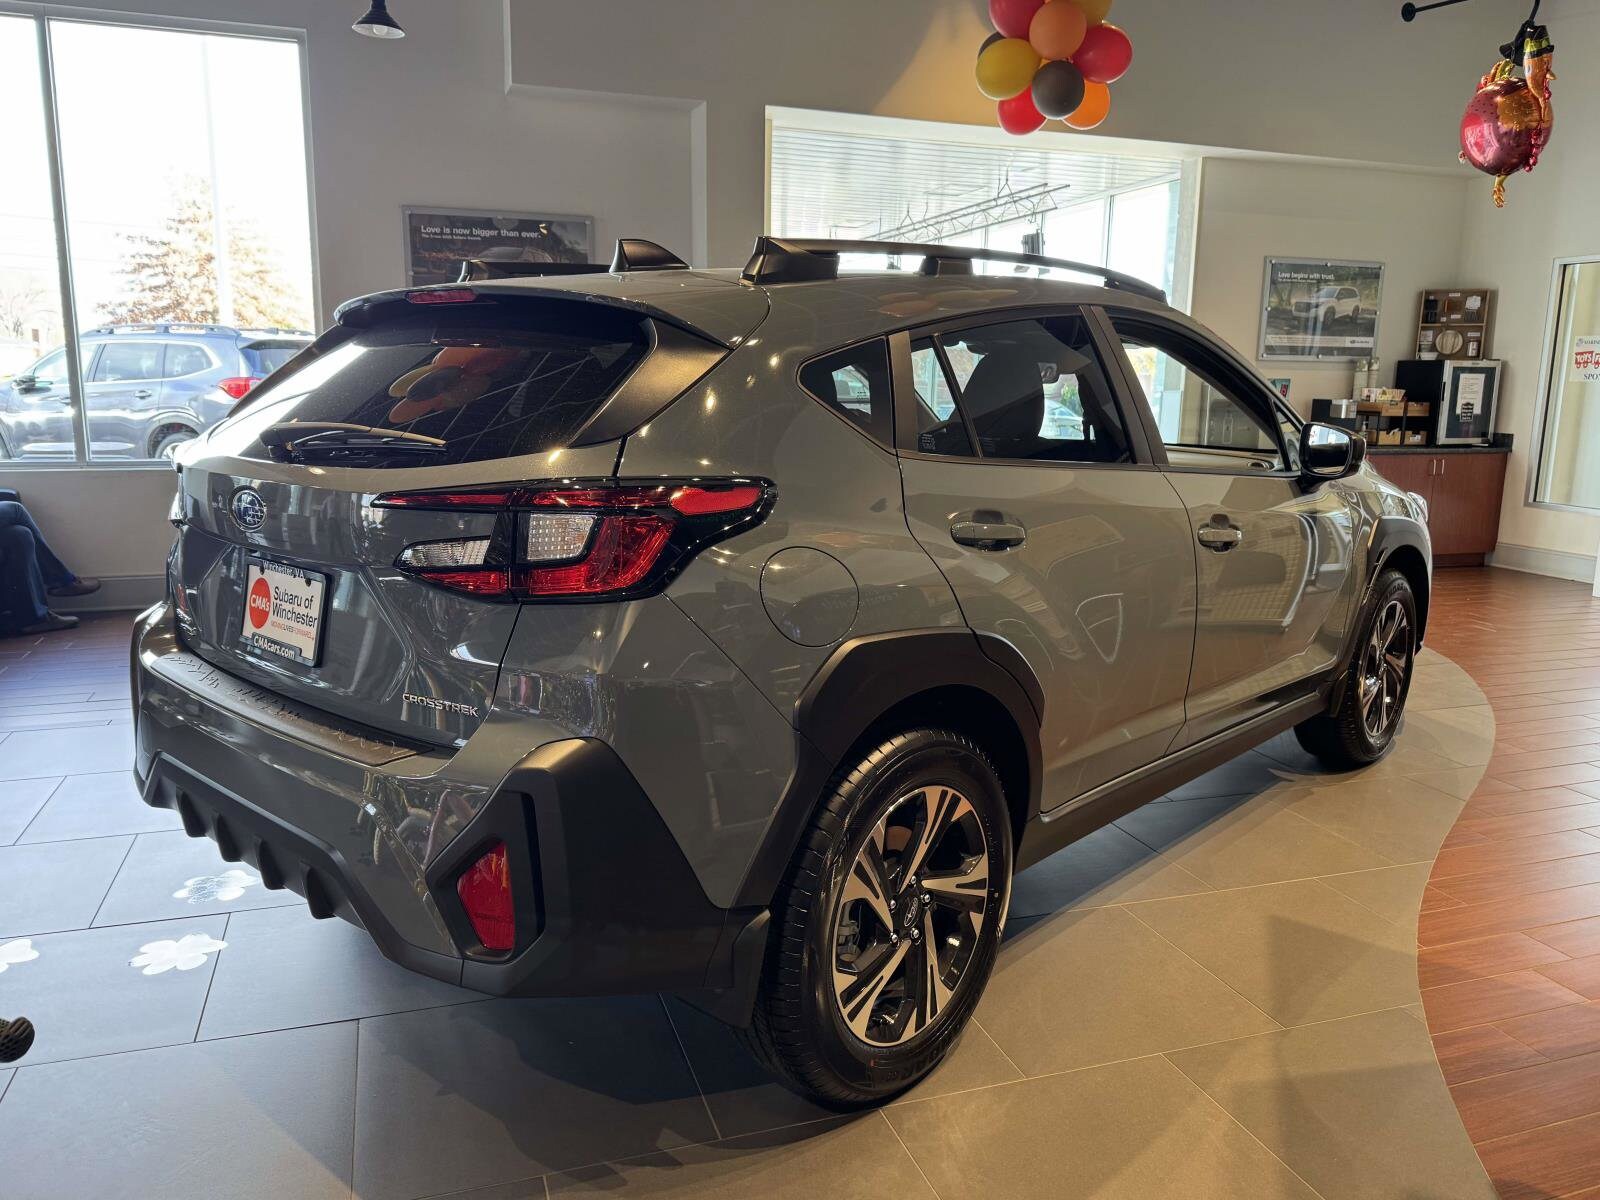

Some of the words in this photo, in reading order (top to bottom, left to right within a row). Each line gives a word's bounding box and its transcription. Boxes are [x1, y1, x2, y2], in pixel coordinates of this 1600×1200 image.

[421, 225, 441, 234] Love
[443, 226, 451, 234] is
[452, 227, 470, 235] now
[472, 227, 498, 237] bigger
[500, 229, 519, 237] than
[521, 231, 542, 239] ever.
[1291, 272, 1309, 280] begins
[1577, 353, 1592, 363] TOYS
[1584, 373, 1600, 381] SPO
[294, 568, 305, 579] VA
[250, 594, 270, 611] CMA's
[273, 586, 303, 607] Subaru
[304, 595, 315, 610] of
[272, 601, 318, 628] Winchester
[253, 635, 295, 660] CMAcars.com
[402, 692, 479, 717] CROSSTREK
